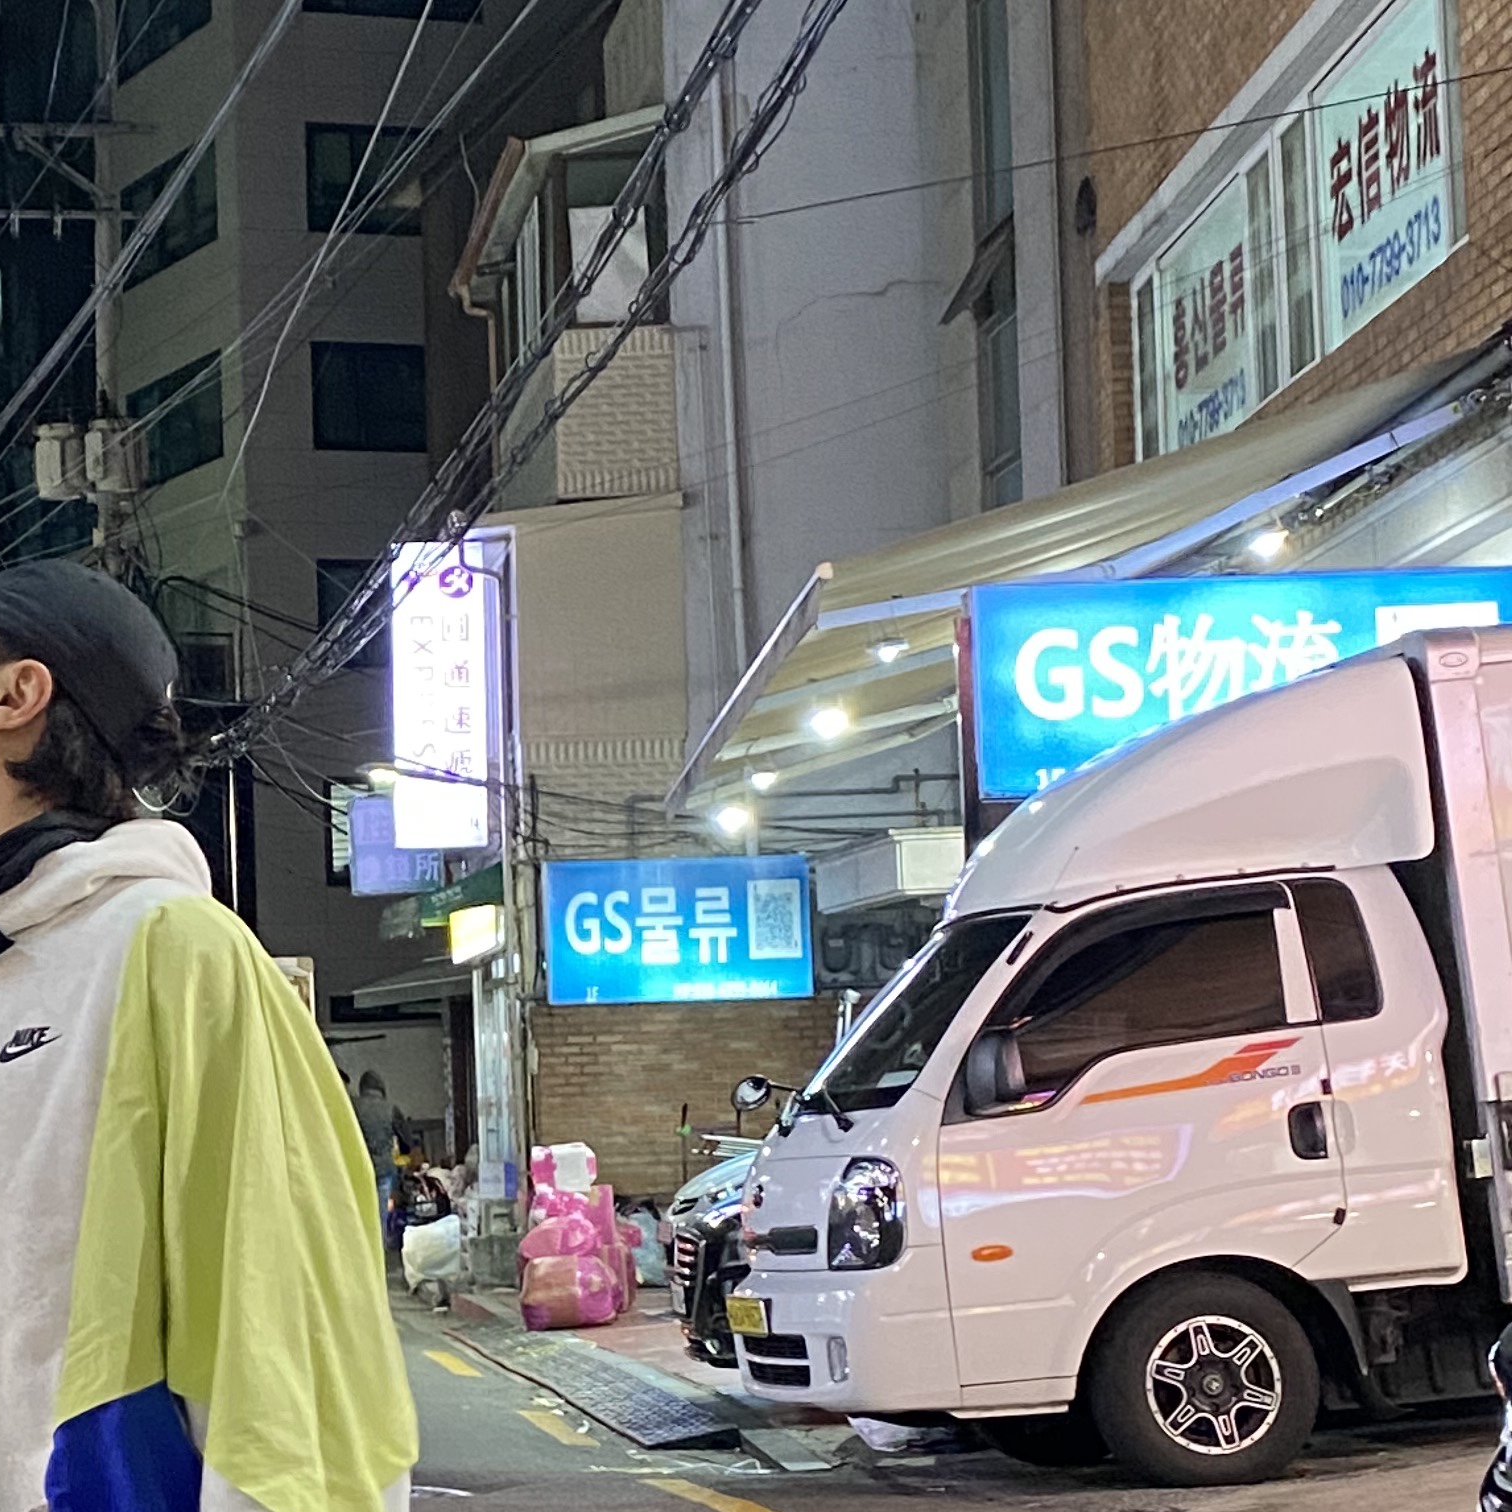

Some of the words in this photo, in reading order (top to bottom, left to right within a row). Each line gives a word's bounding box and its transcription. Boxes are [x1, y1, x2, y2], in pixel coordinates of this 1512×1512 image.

[1330, 46, 1440, 242] 宏信物流
[1173, 243, 1245, 391] 홍신물류
[1341, 195, 1442, 319] 010-7799-3713
[565, 886, 738, 965] GS물류
